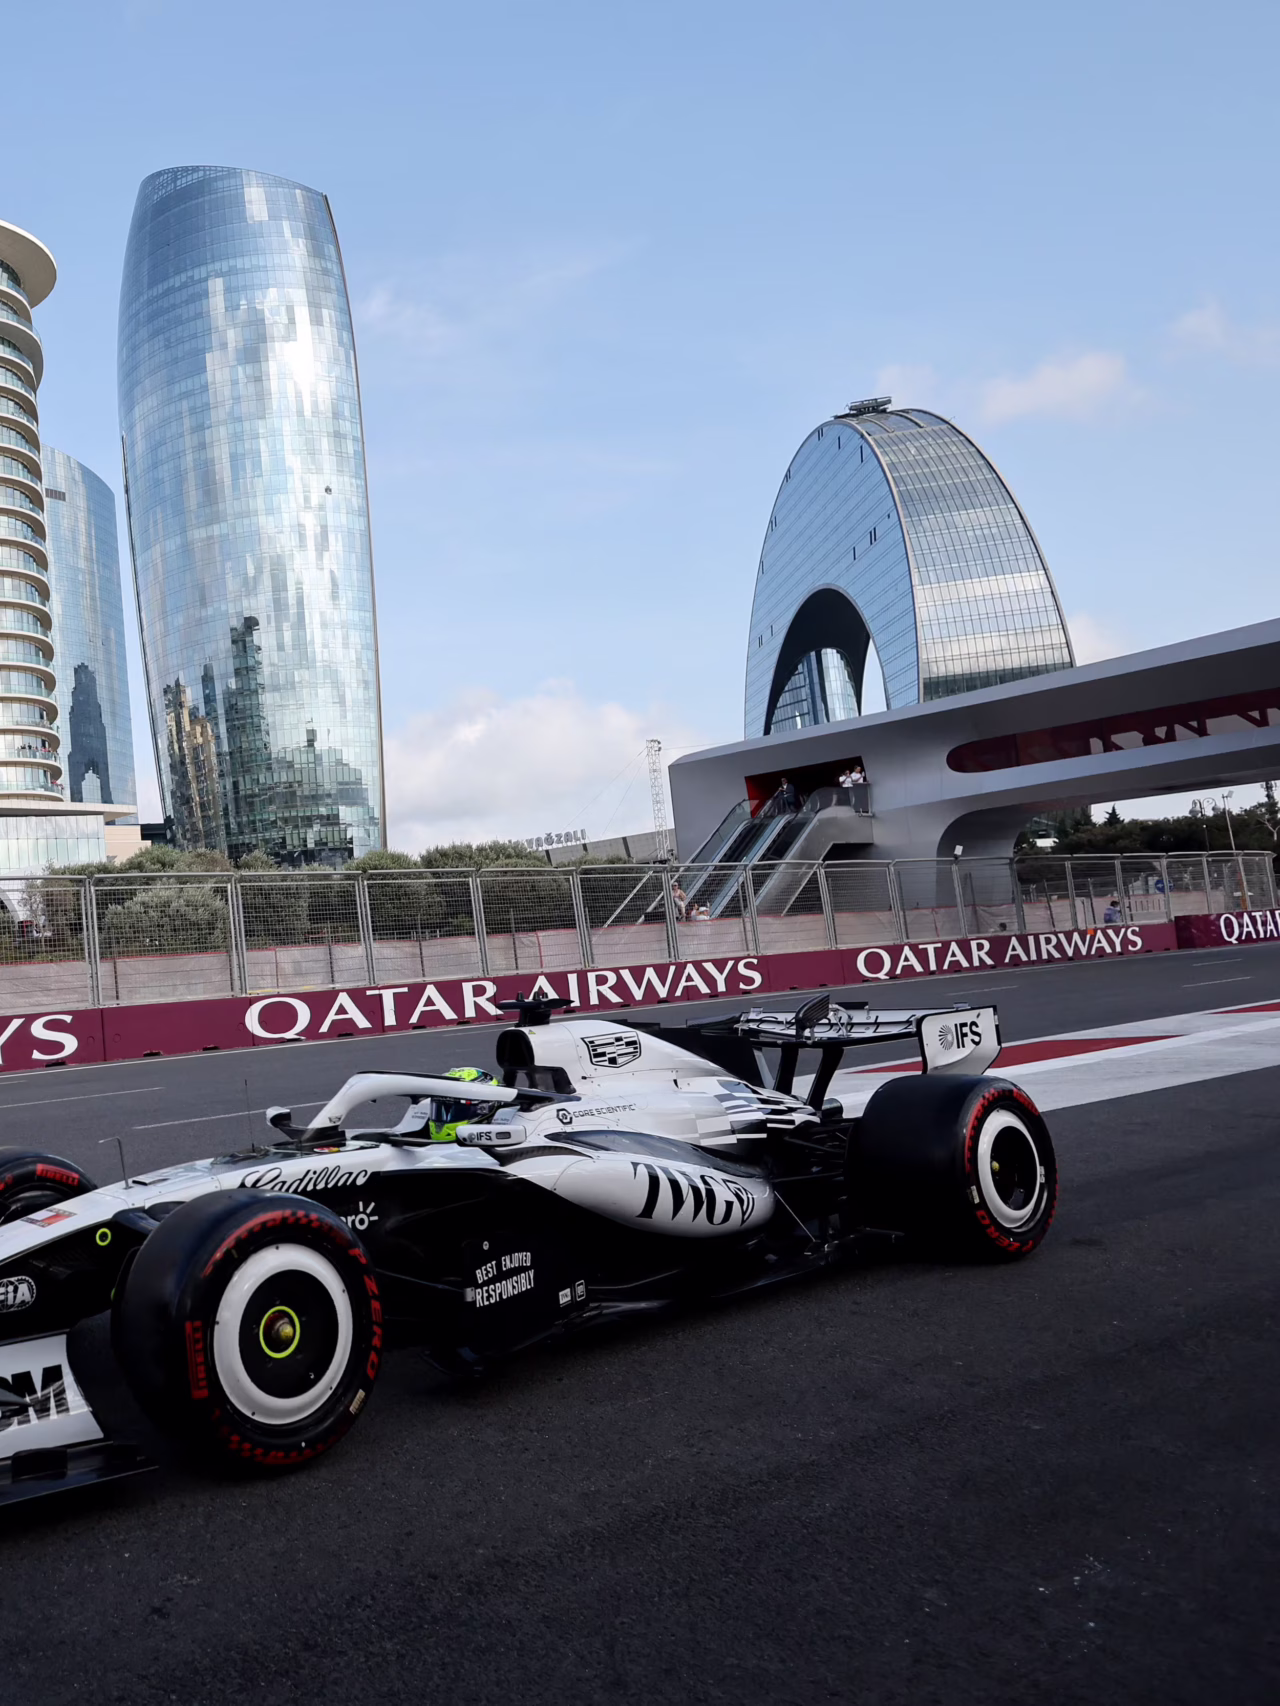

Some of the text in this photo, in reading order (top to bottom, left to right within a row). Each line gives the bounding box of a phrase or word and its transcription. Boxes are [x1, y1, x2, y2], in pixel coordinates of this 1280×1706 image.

[857, 926, 1143, 980] QATAR AIRWAYS
[245, 958, 763, 1040] QATAR AIRWAYS
[954, 1021, 982, 1049] IFS
[573, 1104, 636, 1118] CORE SCIENTIFIC
[476, 1131, 492, 1141] IFS
[238, 1165, 368, 1193] Cadillac
[475, 1252, 531, 1284] BEST ENJOYED
[475, 1269, 535, 1307] RESPONSIBLY
[363, 1275, 383, 1380] ZERO
